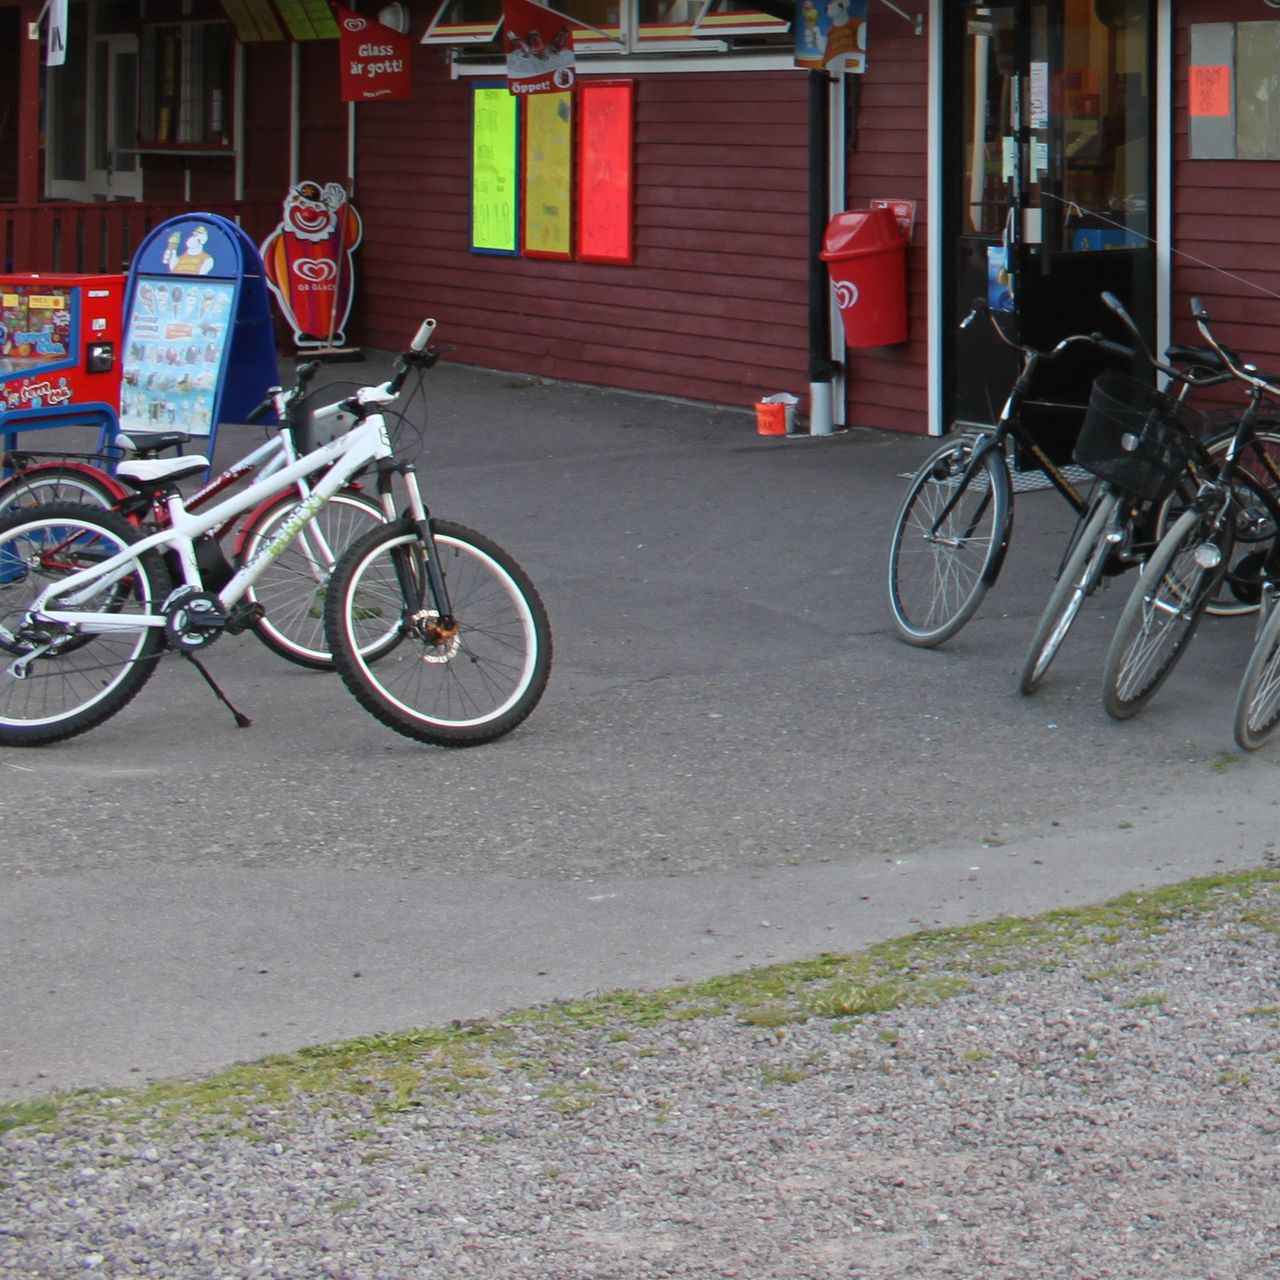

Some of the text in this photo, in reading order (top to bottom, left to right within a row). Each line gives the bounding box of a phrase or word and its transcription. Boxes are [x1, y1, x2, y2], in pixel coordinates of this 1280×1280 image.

[358, 43, 394, 57] Glass
[350, 59, 403, 78] är gott!
[511, 80, 551, 94] Öppet!
